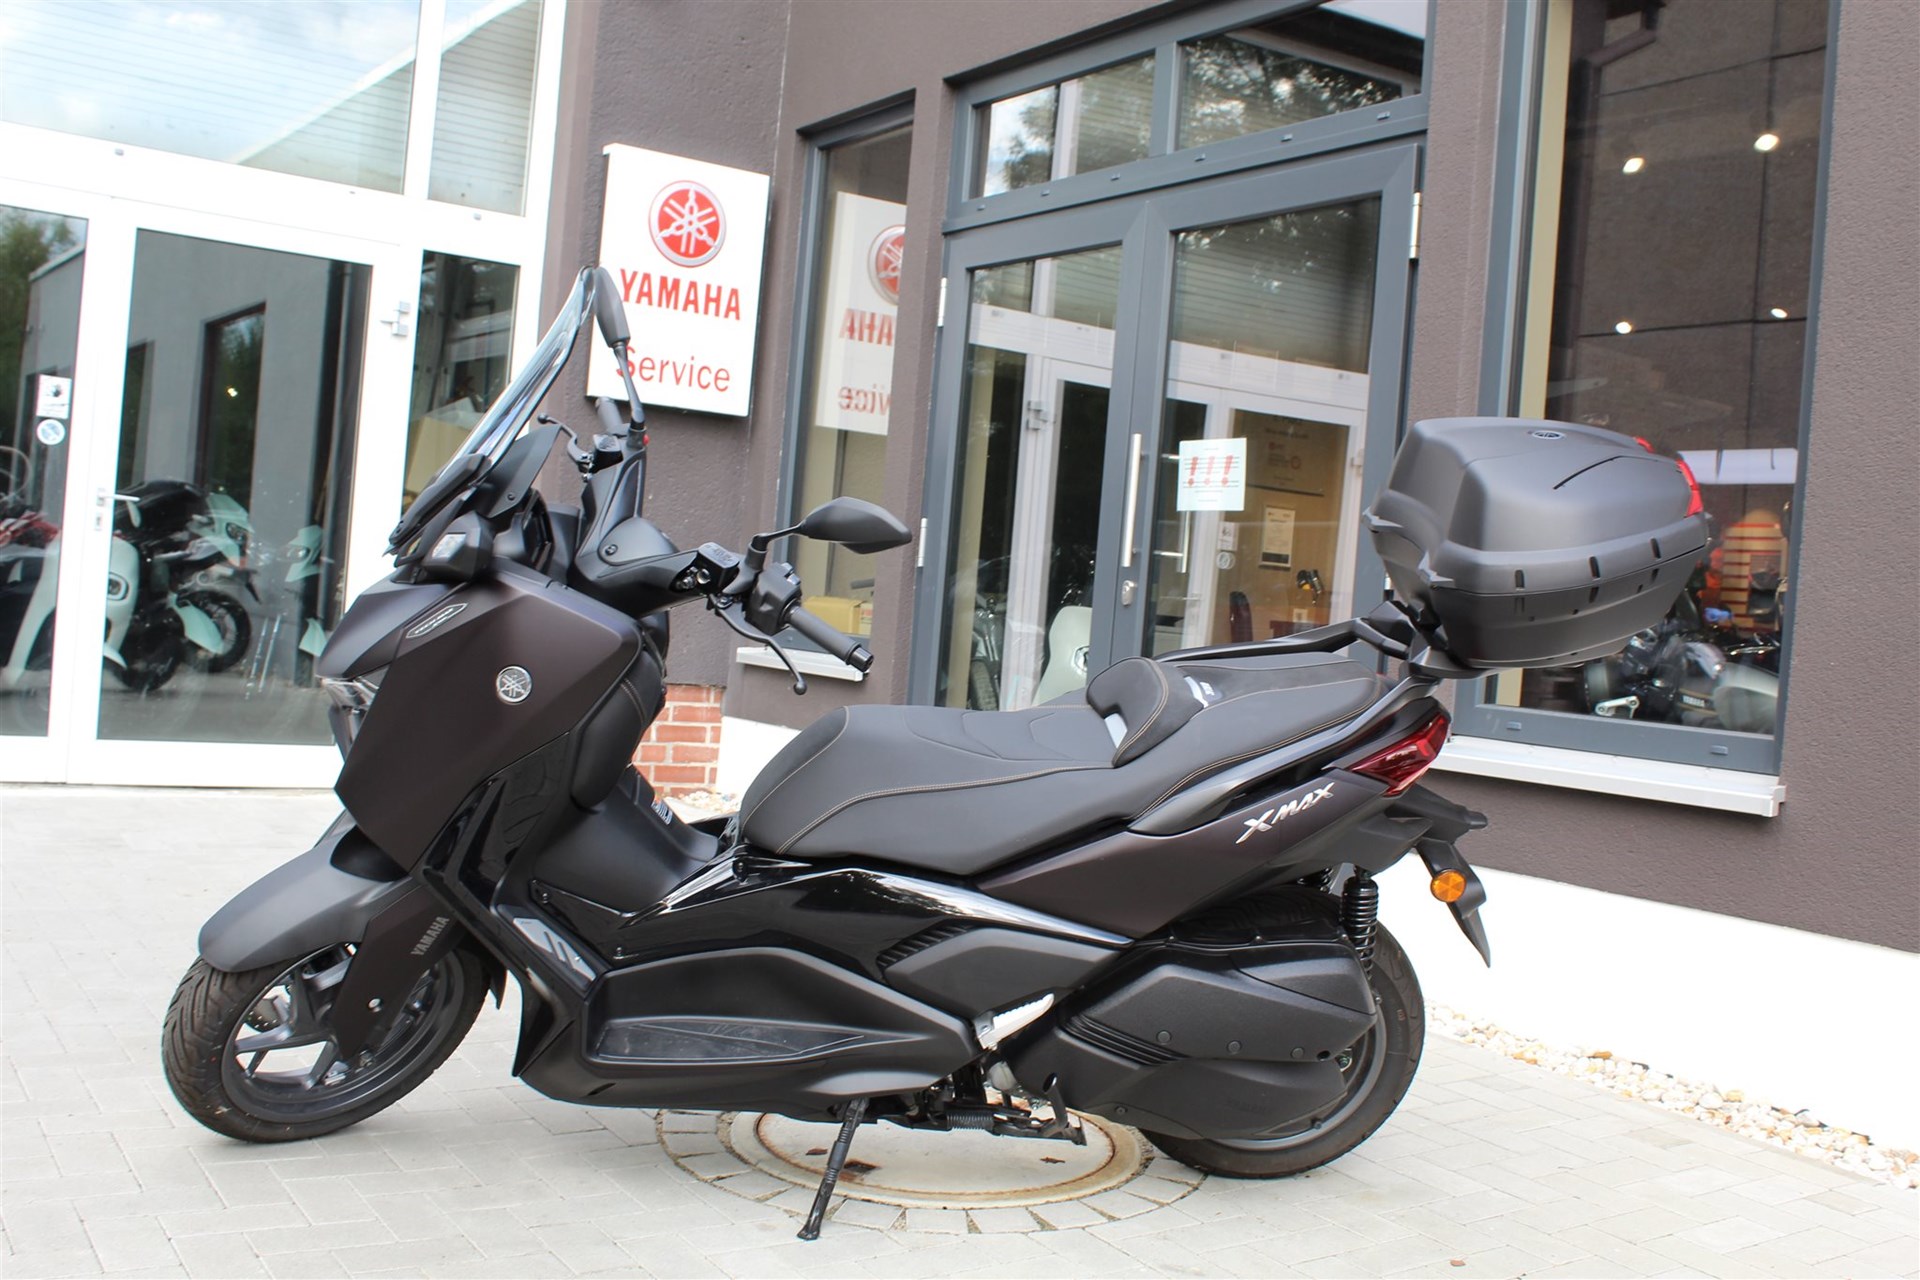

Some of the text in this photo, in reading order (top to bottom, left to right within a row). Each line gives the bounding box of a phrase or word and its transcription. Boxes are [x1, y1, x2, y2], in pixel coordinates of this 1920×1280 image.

[620, 268, 741, 321] YAMAHA
[616, 345, 731, 392] Service
[410, 916, 450, 956] YAMAHA
